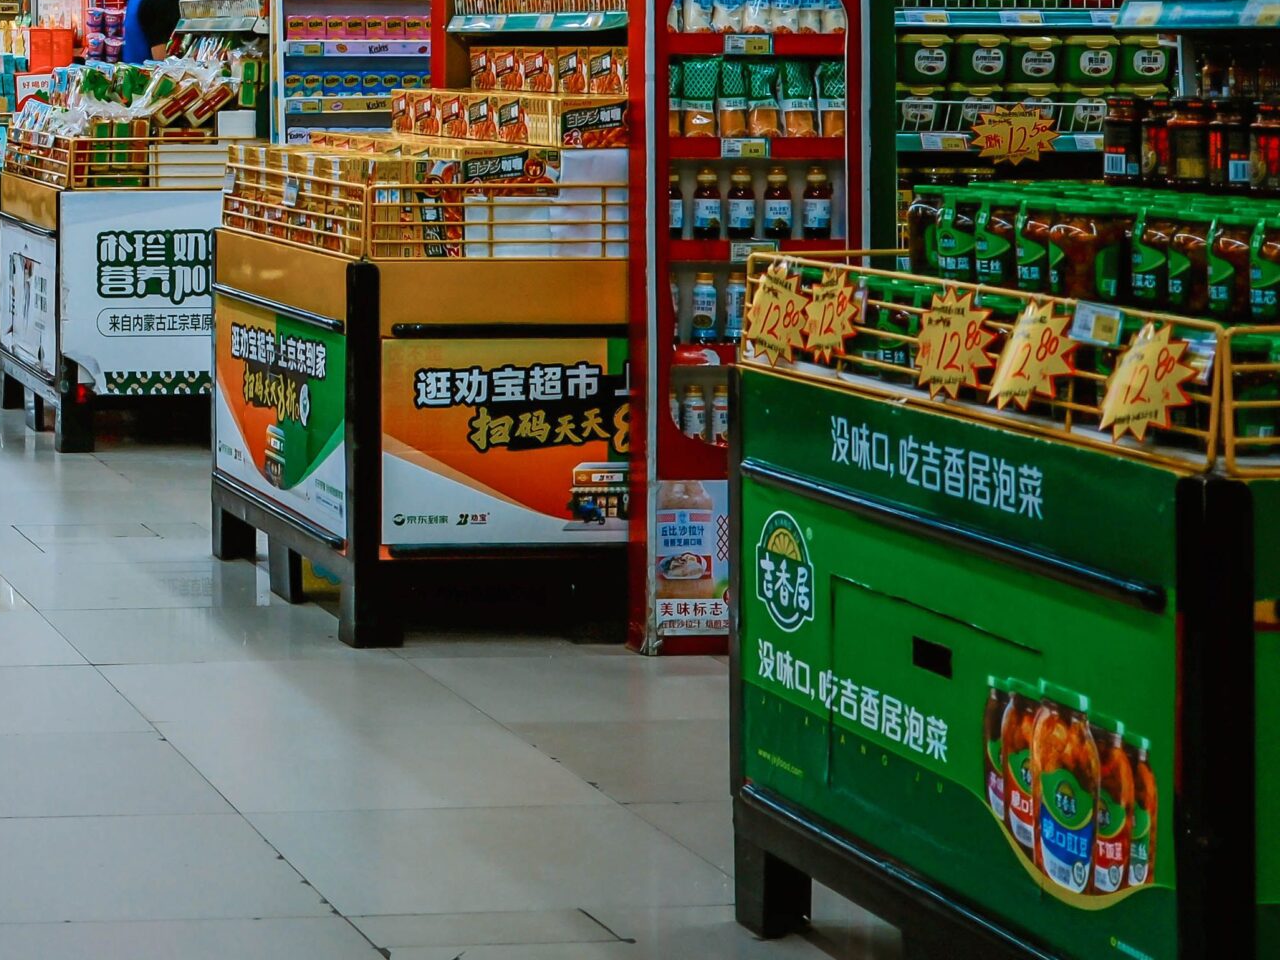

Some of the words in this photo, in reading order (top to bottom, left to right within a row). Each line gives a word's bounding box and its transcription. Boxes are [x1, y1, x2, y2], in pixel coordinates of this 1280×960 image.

[100, 233, 212, 262] 朴珍奶
[100, 265, 212, 303] 营养加
[109, 313, 212, 332] 来自内蒙古正宗草原
[231, 325, 276, 367] 逛劝宝超市
[277, 337, 327, 380] 上京东到家
[417, 364, 601, 408] 逛劝宝超市
[830, 415, 1044, 521] 没味口,吃吉香居泡菜
[406, 514, 449, 525] 京东到家
[661, 526, 705, 537] 丘比沙拉汁
[760, 551, 810, 611] 吉香居
[660, 602, 729, 617] 美味标志
[758, 637, 949, 763] 没味口,吃吉香居泡菜
